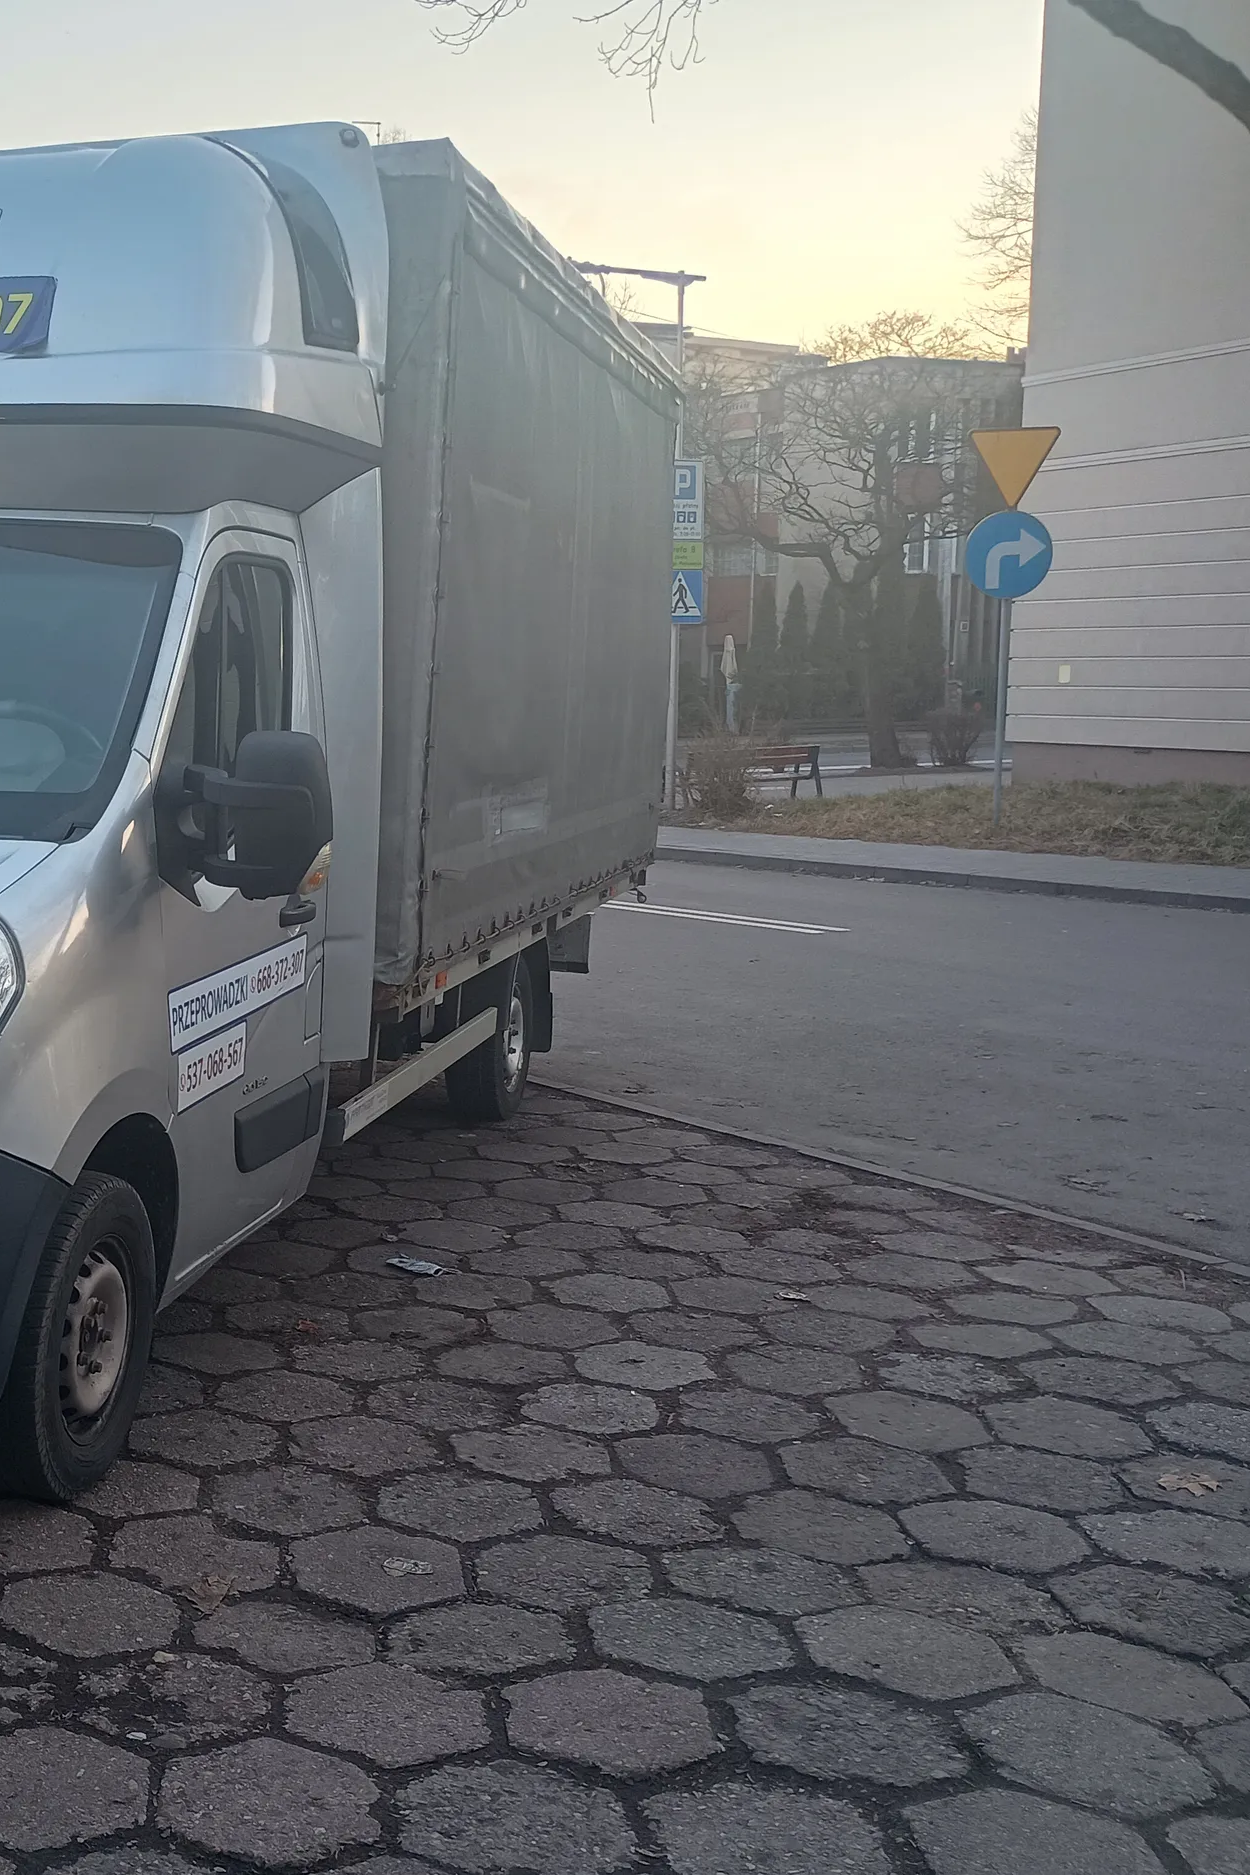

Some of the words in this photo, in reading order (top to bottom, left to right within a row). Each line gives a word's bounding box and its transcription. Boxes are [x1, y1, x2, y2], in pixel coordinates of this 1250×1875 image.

[172, 975, 248, 1036] PRZEPROWADZKI
[256, 949, 305, 993] 668-372-307
[186, 1037, 244, 1092] 537-068-567
